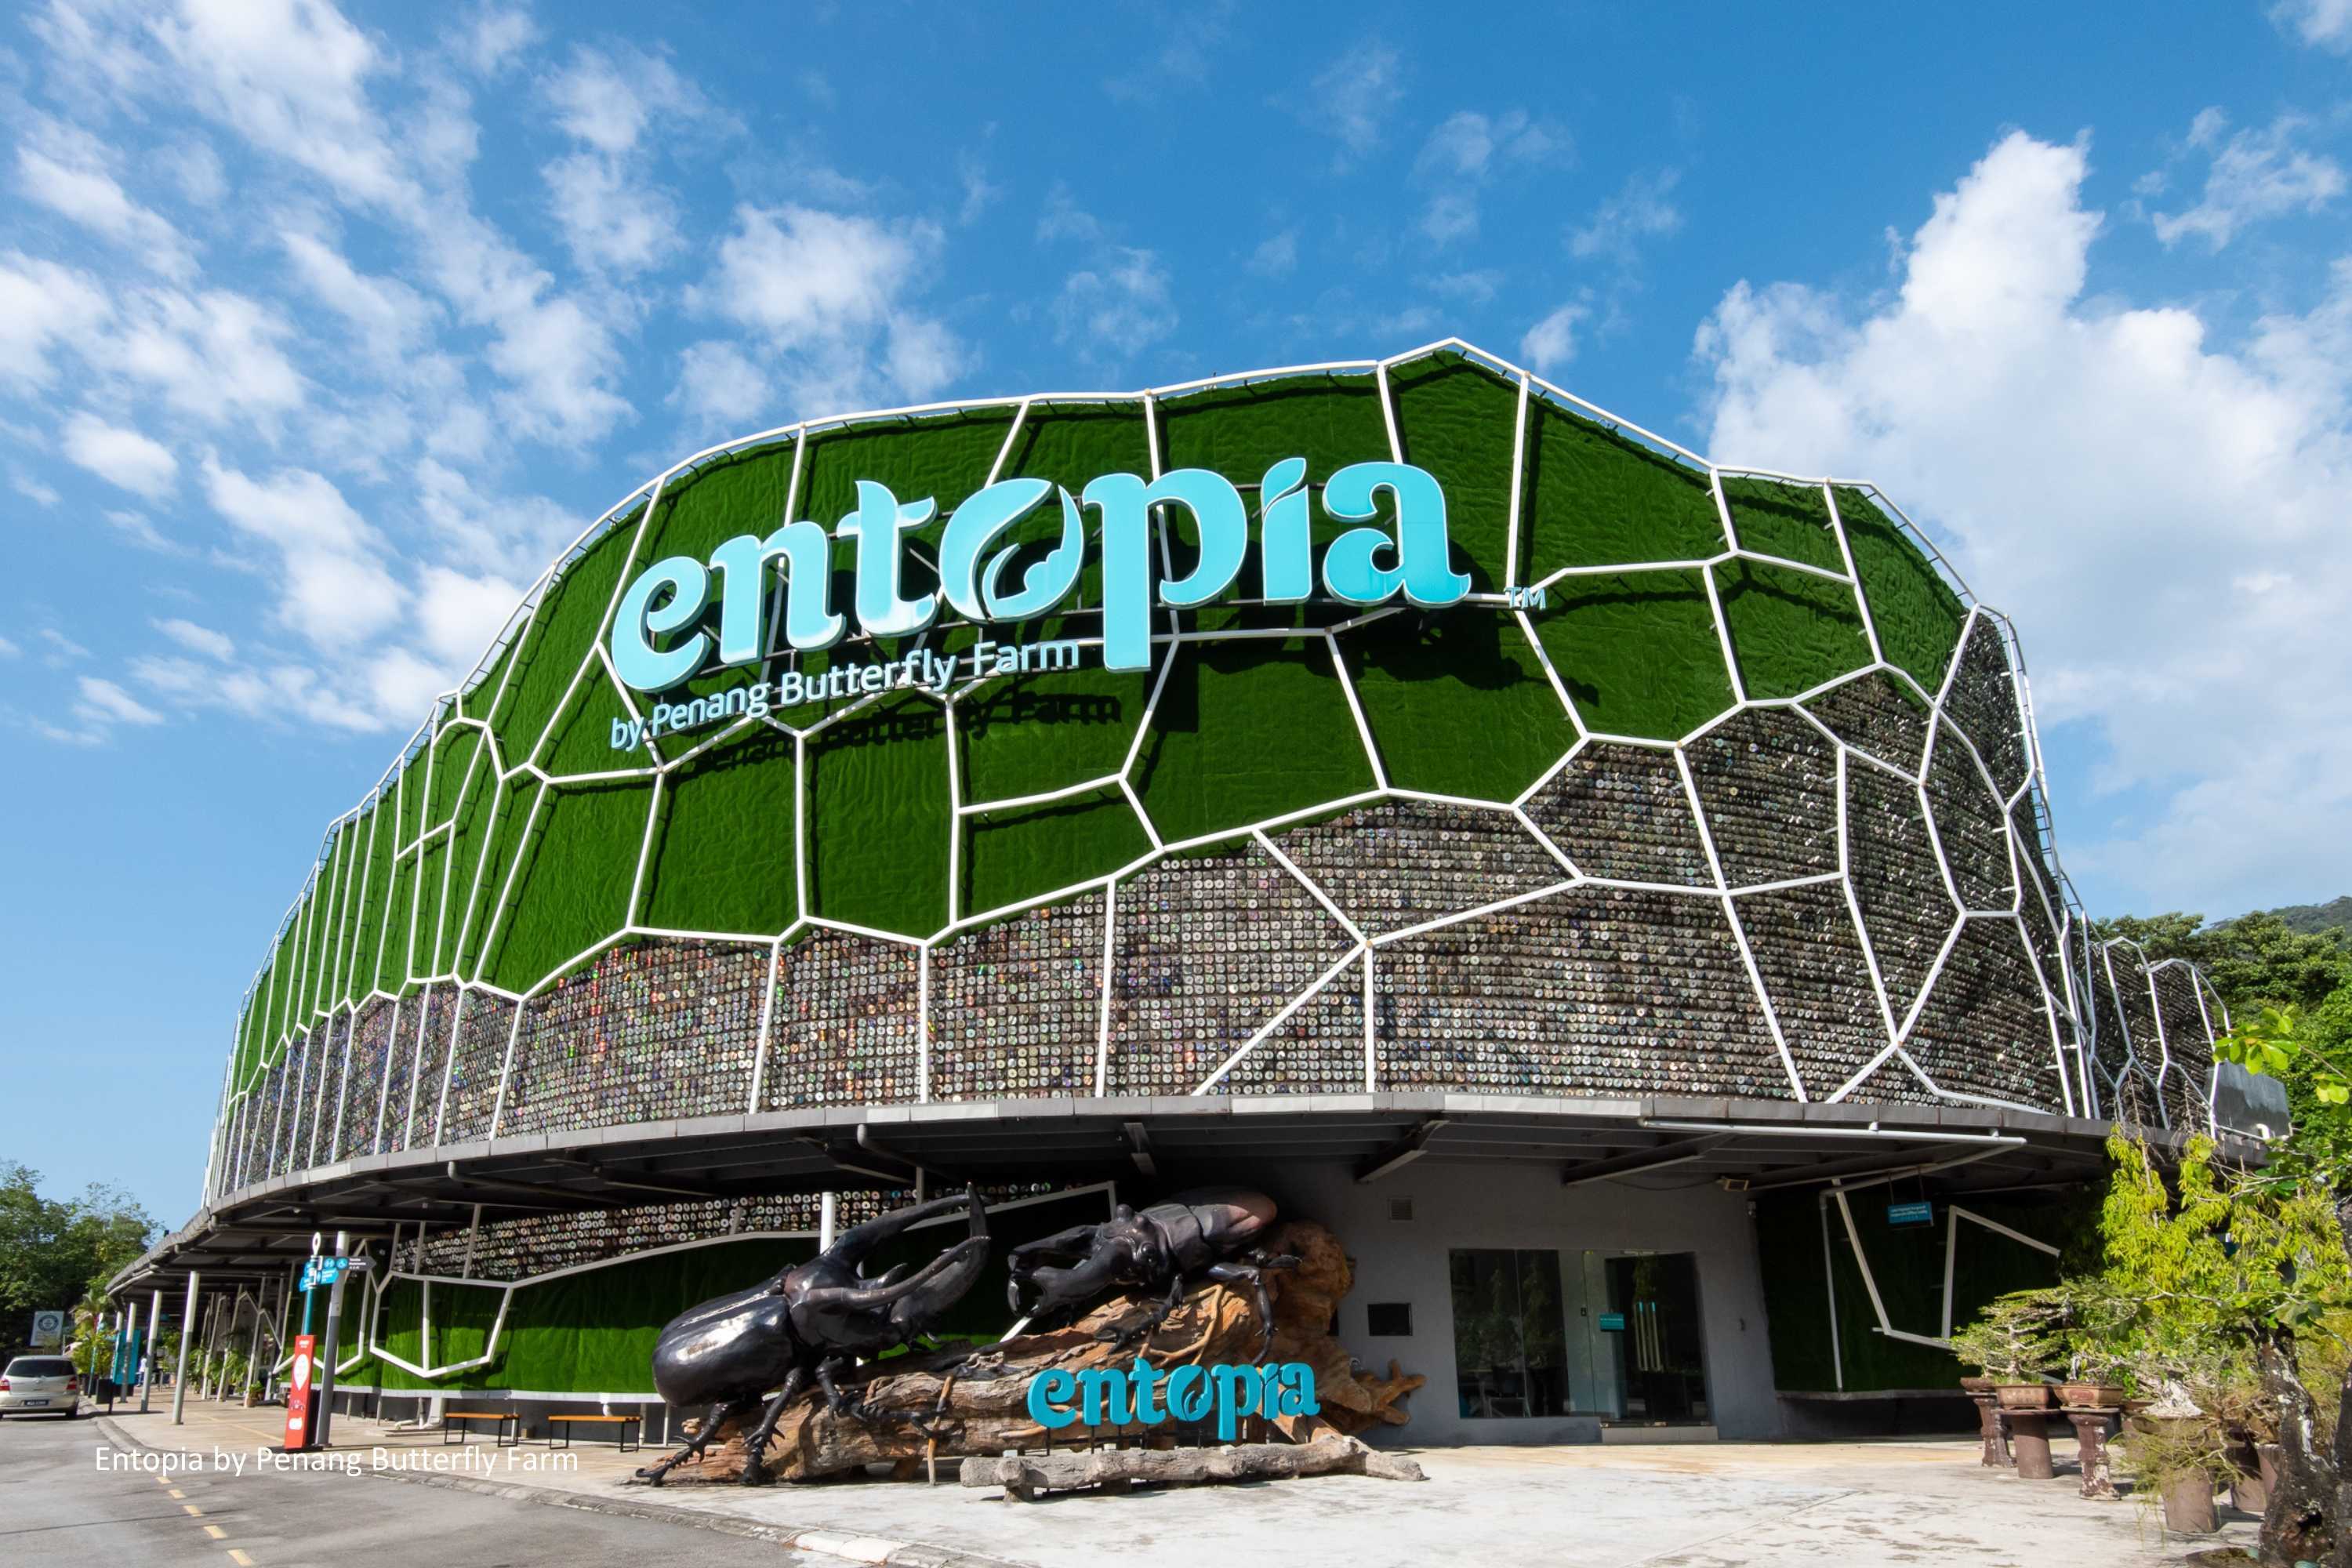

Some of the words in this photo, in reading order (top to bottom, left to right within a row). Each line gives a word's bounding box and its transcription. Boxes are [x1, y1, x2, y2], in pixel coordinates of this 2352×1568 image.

[611, 456, 1472, 694] entopia
[1503, 586, 1547, 611] TM
[612, 717, 646, 752] by
[652, 681, 771, 730] Penang
[781, 648, 959, 705] Butterfly
[974, 639, 1080, 677] Farm
[1027, 1356, 1321, 1441] entopia
